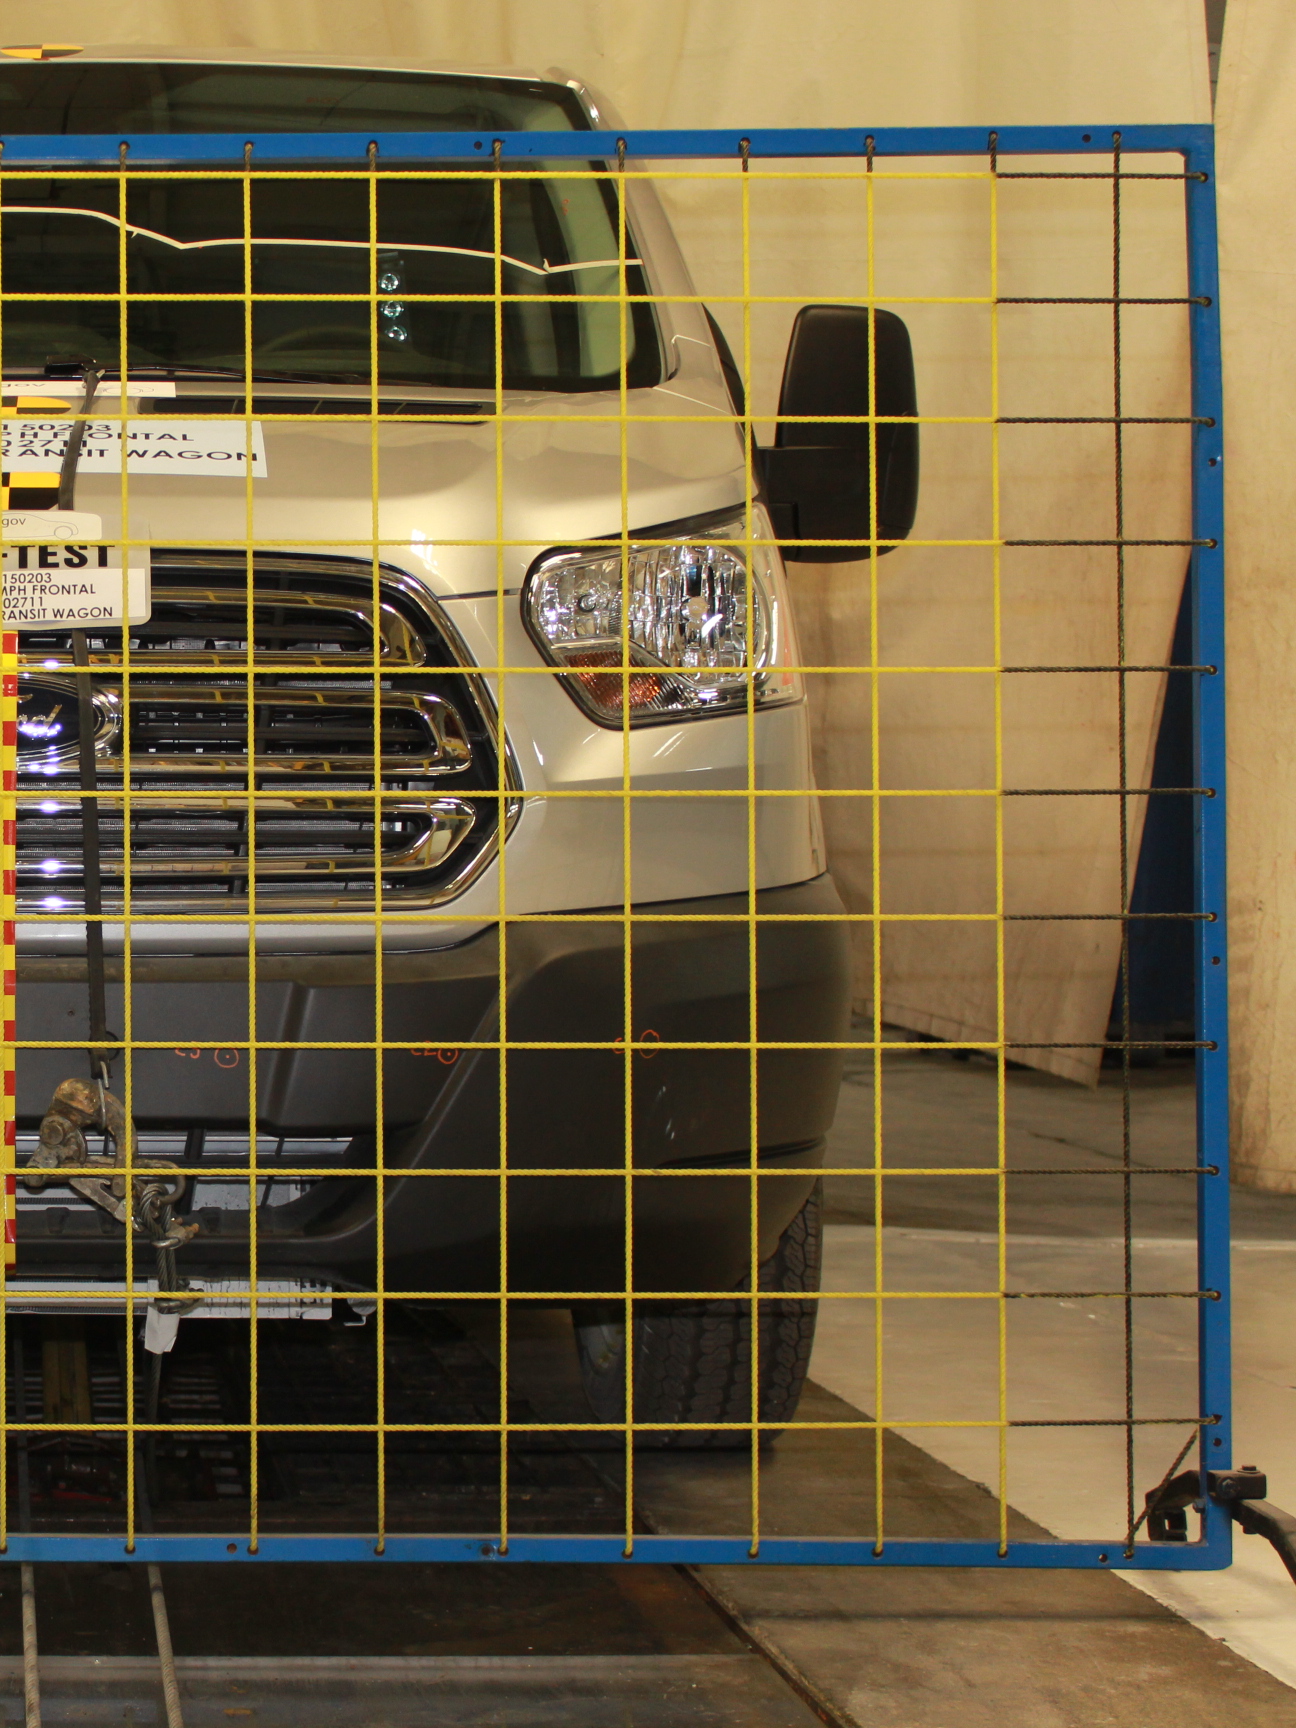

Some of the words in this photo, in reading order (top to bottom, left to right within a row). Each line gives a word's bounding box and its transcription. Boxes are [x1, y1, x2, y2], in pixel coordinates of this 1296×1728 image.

[53, 431, 194, 441] FONTAL
[120, 449, 258, 462] WAGON
[32, 583, 96, 595] FRONTAL
[52, 606, 113, 619] WAGON
